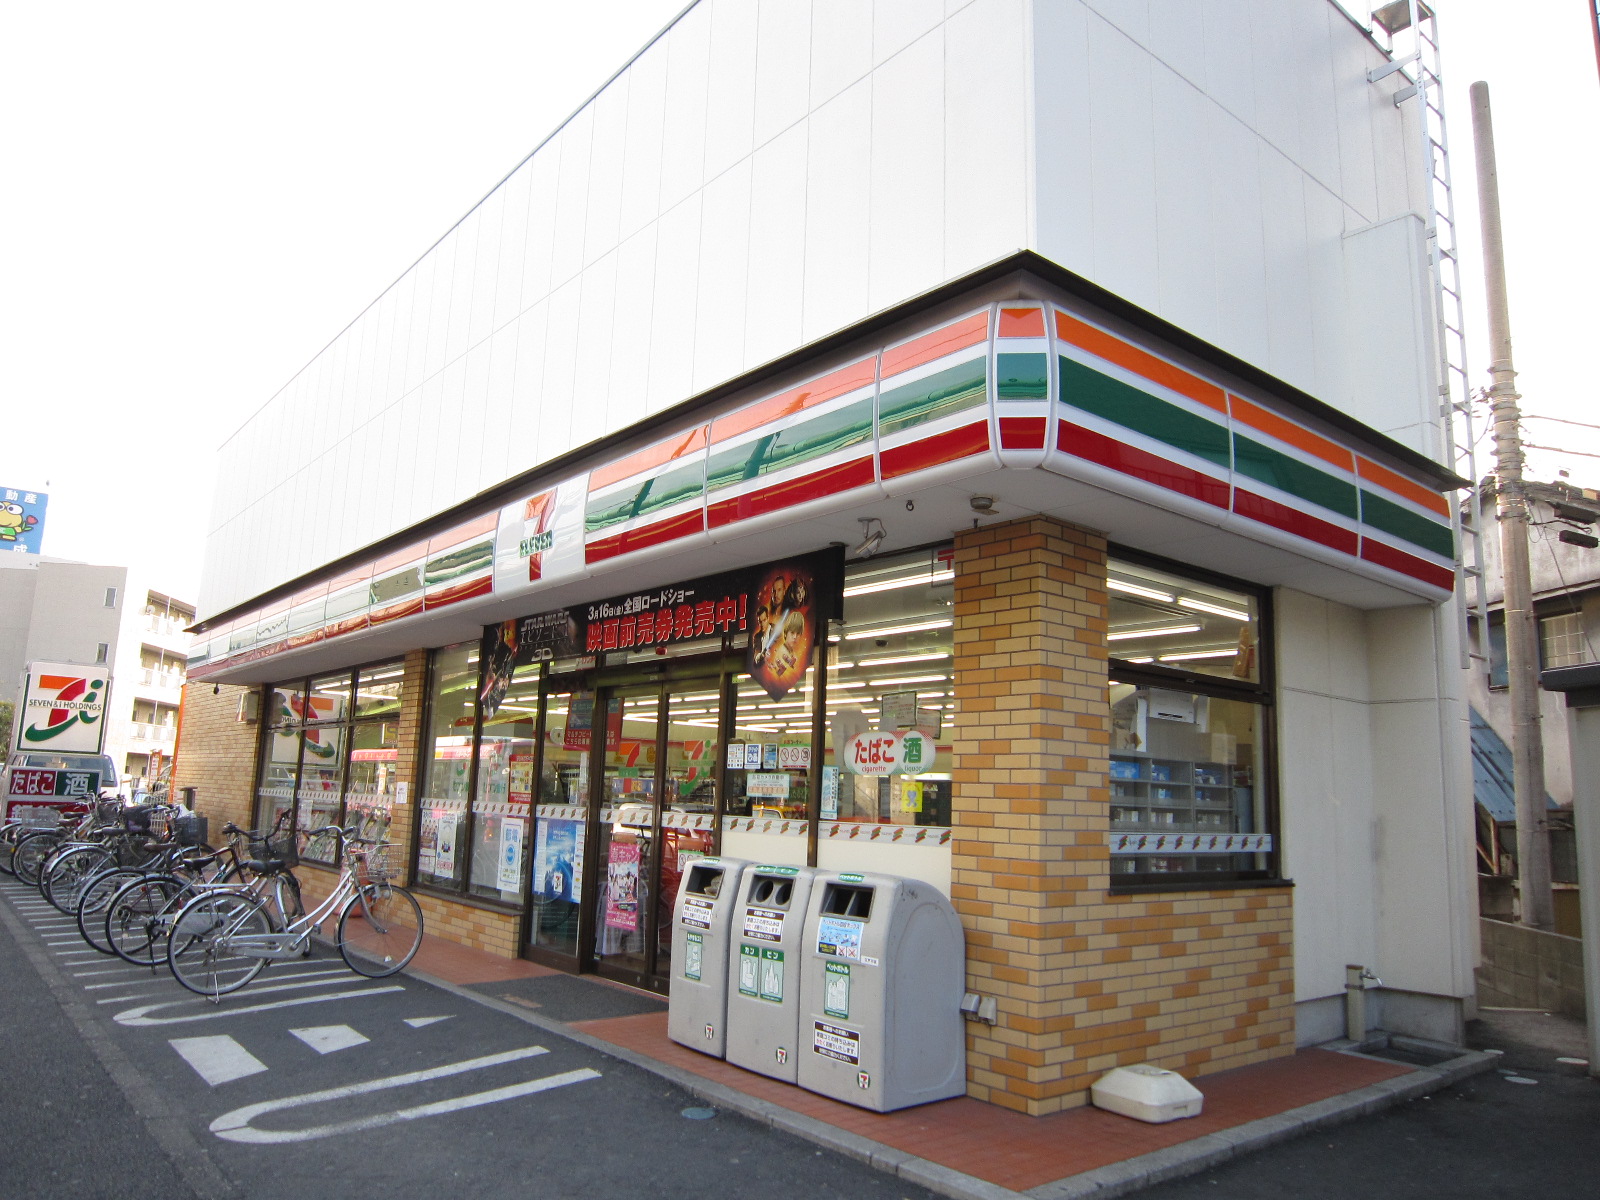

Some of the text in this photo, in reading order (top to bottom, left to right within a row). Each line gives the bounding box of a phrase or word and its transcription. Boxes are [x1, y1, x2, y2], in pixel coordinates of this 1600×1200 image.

[521, 611, 569, 632] STAR WARS
[586, 594, 748, 652] 映画前売券発売中!
[531, 647, 554, 661] 3D
[855, 737, 922, 764] たばこ 酒
[862, 764, 922, 773] cigarette liquor
[11, 771, 90, 796] たばこ 酒
[744, 946, 755, 955] カン
